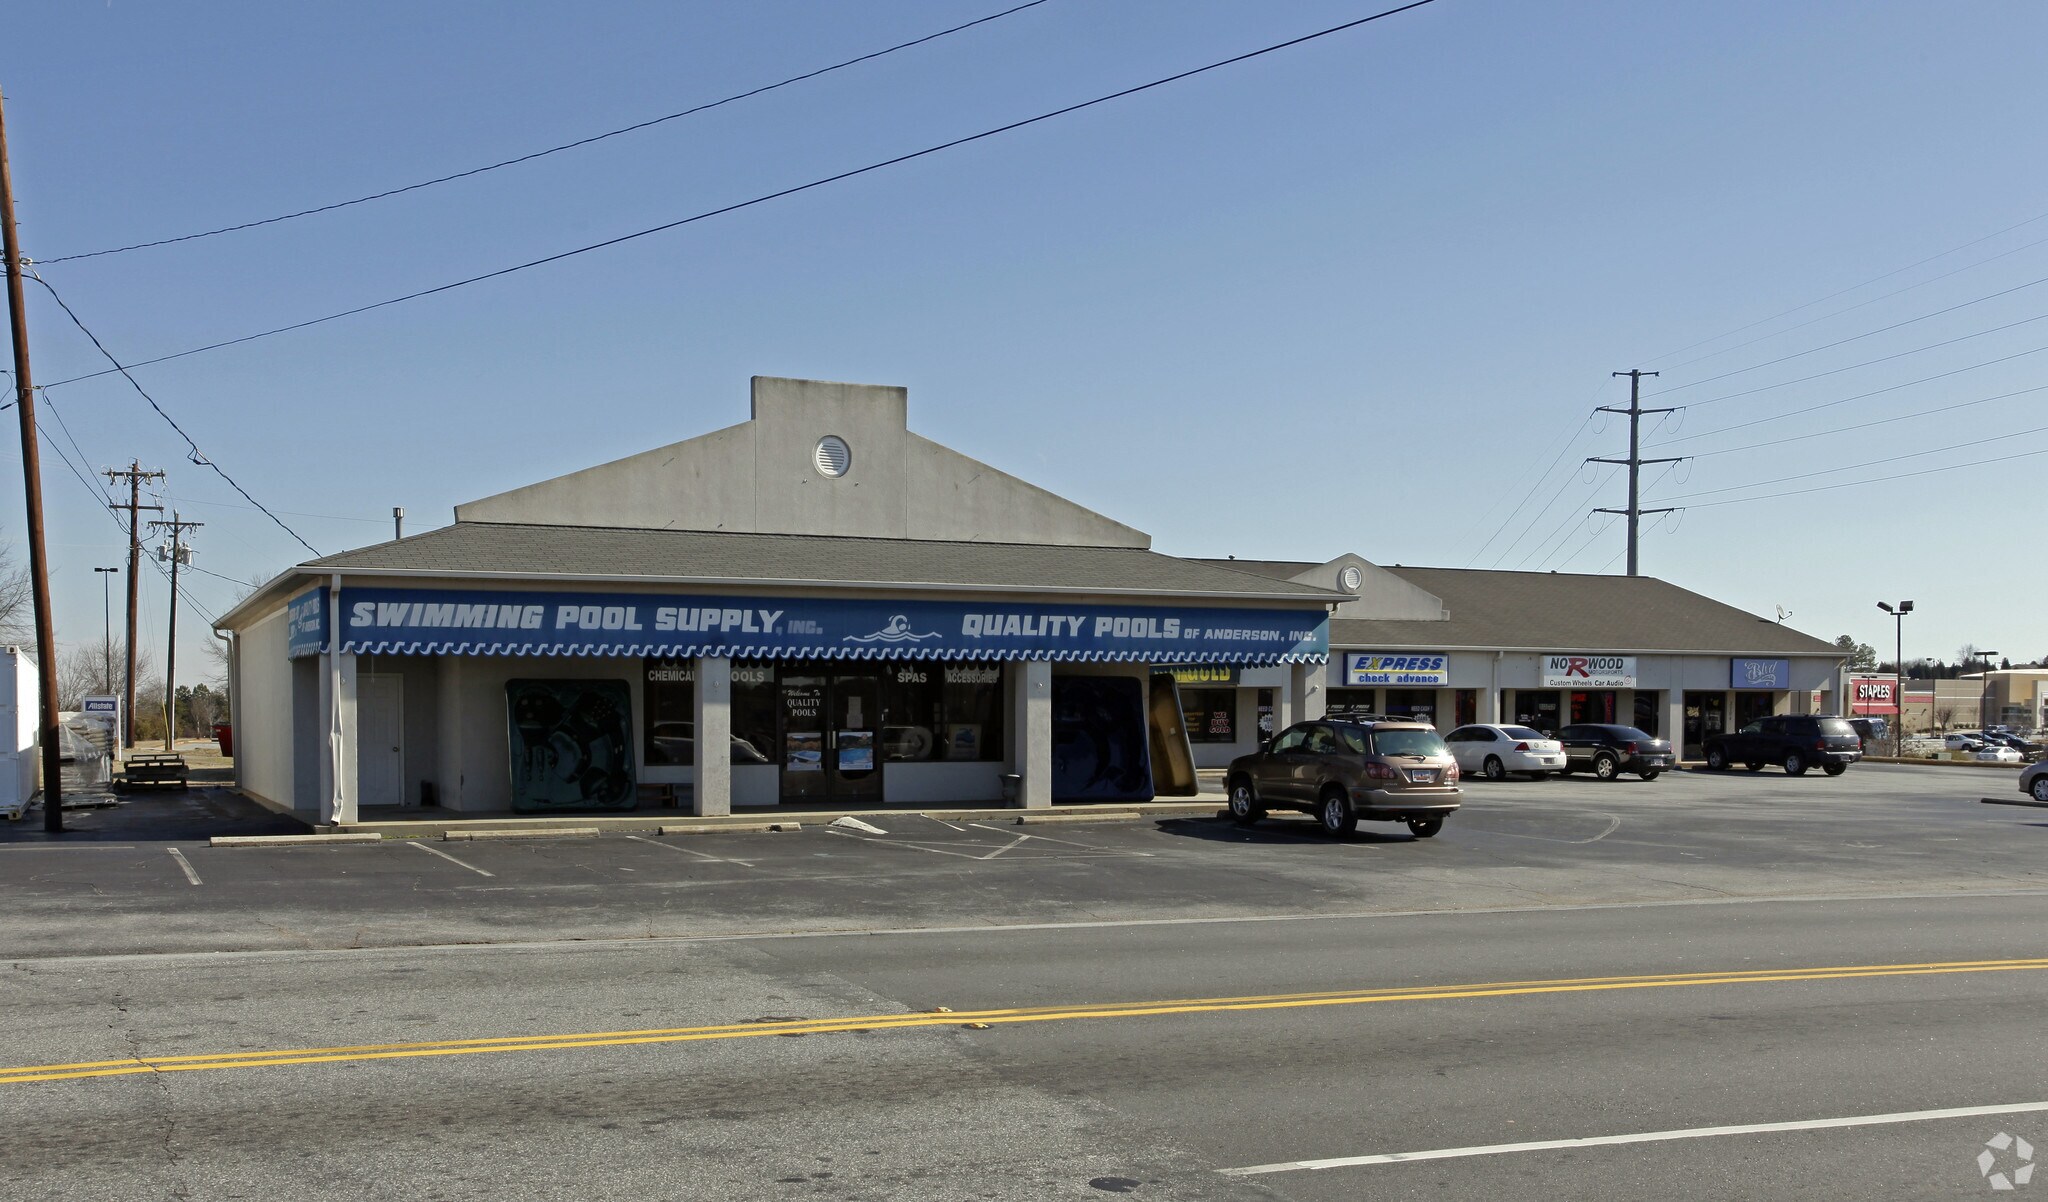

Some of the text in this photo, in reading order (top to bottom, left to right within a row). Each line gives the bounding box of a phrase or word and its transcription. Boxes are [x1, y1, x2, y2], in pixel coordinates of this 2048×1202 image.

[350, 602, 544, 629] SWIMMING
[555, 605, 642, 631] POOL
[787, 620, 824, 635] INC.
[962, 614, 1086, 638] QUALITY
[1094, 616, 1181, 639] POOLS
[1184, 628, 1200, 639] OF
[1354, 656, 1443, 670] EXPRESS
[1550, 657, 1624, 678] NORWOOD
[731, 671, 765, 682] OOLS
[897, 672, 927, 683] SPAS
[946, 673, 998, 683] ACCESSORIES
[1359, 673, 1439, 683] check advance
[1859, 684, 1890, 698] STAPLES
[87, 702, 113, 710] Allstate
[787, 699, 821, 708] QUALITY
[792, 709, 817, 717] POOLS
[1208, 726, 1231, 734] GOLD
